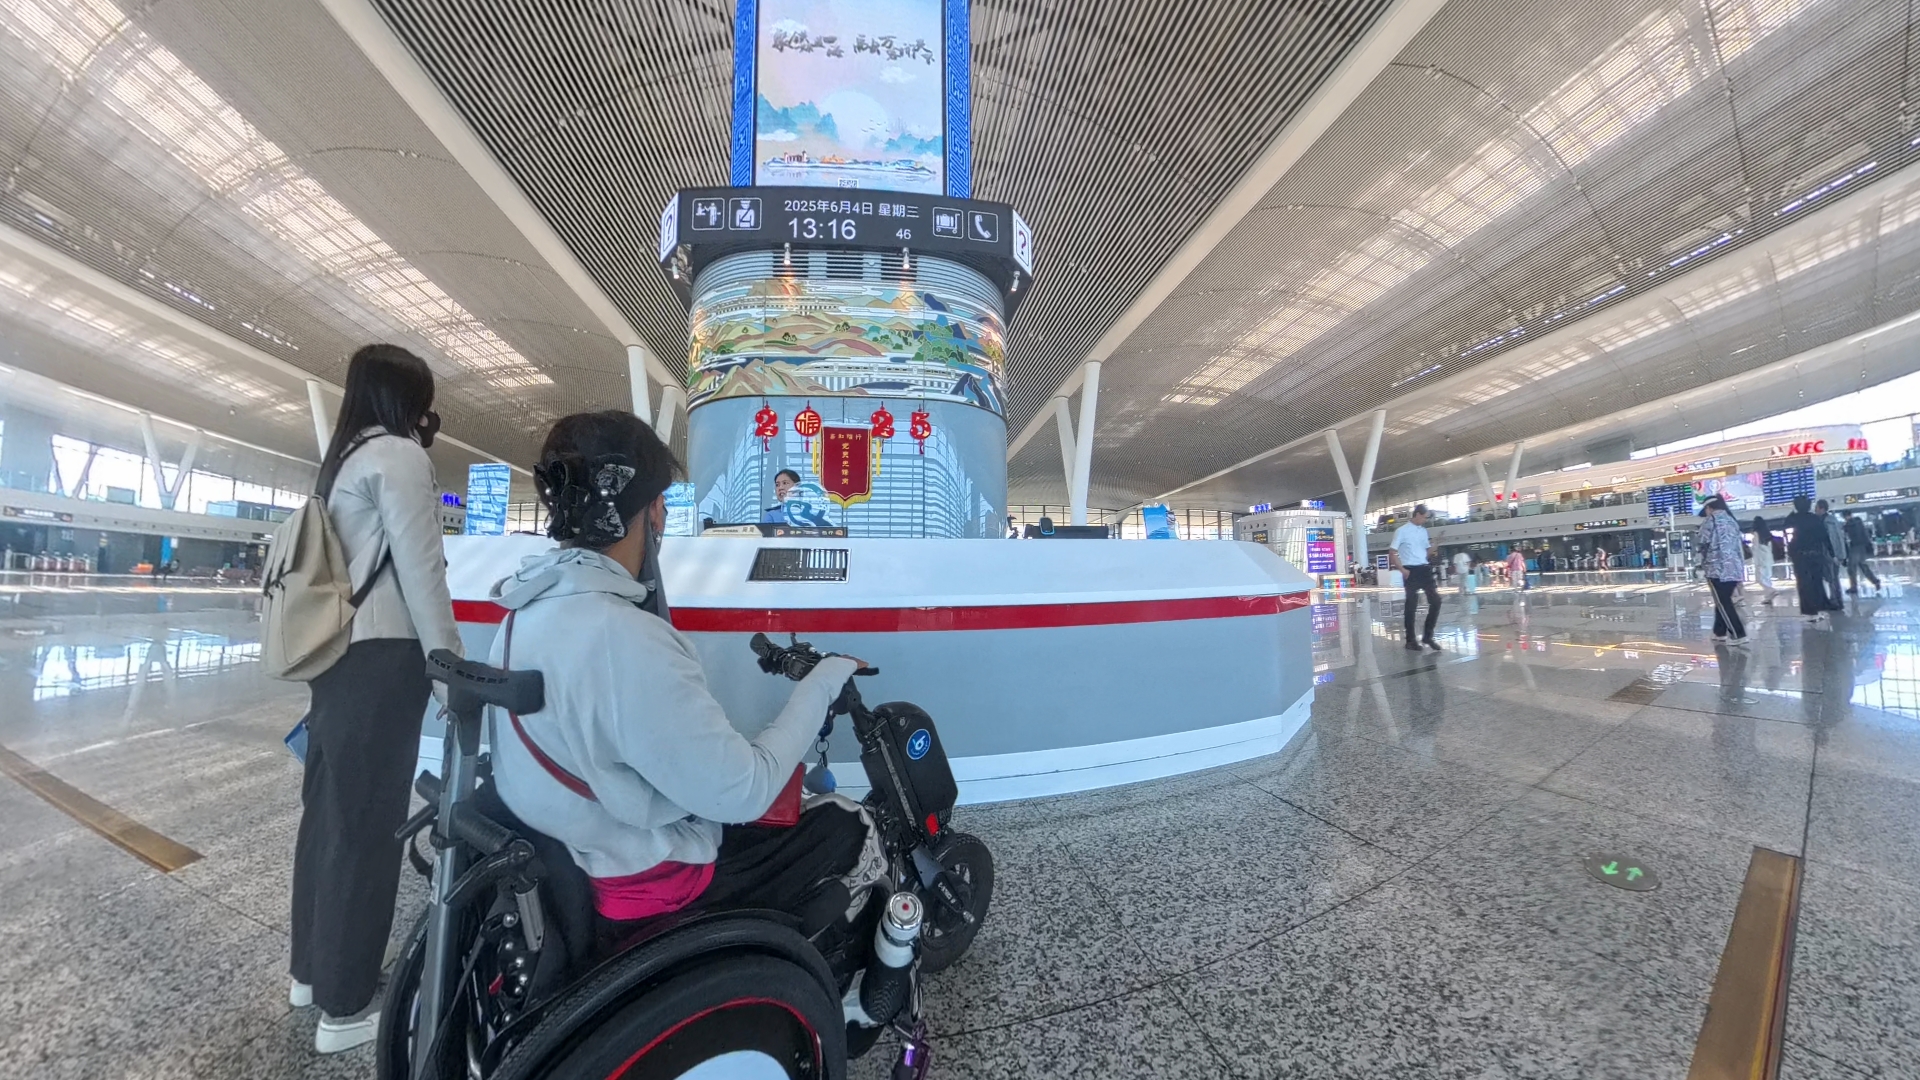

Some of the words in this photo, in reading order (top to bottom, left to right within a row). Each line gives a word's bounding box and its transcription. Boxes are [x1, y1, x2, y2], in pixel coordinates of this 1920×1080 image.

[784, 200, 873, 215] 2025年6月4日
[878, 203, 920, 218] 星期三
[788, 217, 857, 240] 13:16
[895, 228, 912, 240] 46
[795, 410, 821, 436] 福
[1788, 441, 1825, 456] KFC
